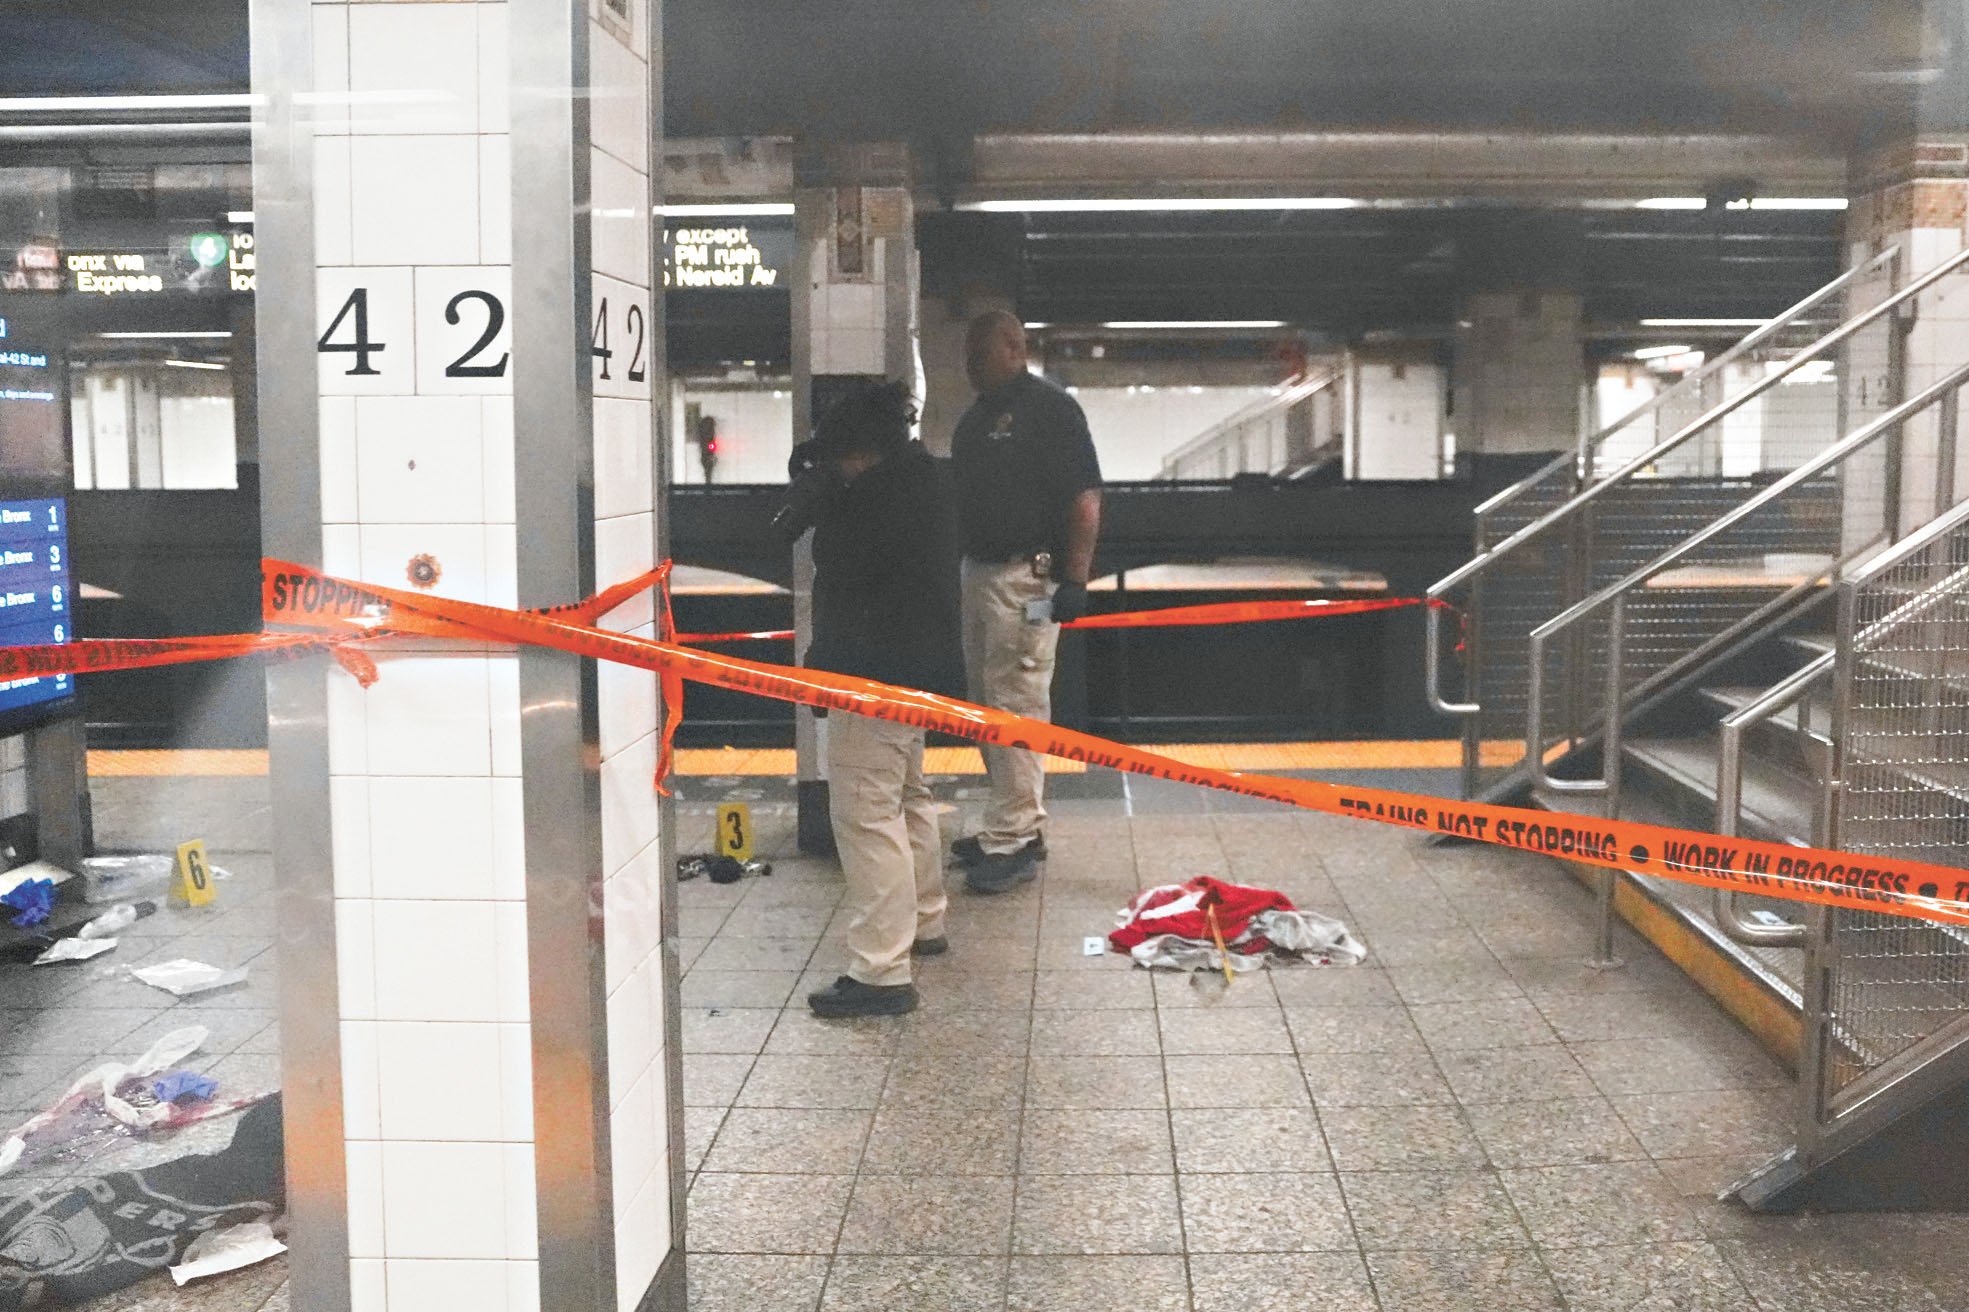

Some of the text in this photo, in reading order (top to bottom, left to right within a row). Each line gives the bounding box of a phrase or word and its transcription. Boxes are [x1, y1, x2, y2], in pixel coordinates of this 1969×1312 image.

[199, 236, 217, 259] 4
[676, 226, 749, 247] except
[675, 244, 761, 265] PM rush
[77, 271, 163, 295] Express
[2, 509, 31, 523] Bronx
[48, 505, 57, 523] 1
[4, 551, 33, 565] Bronx
[50, 545, 60, 563] 3
[7, 592, 36, 606] Bronx
[52, 584, 62, 603] 6
[54, 624, 64, 642] 6
[727, 811, 744, 849] 3
[1438, 811, 1488, 840] NOT
[1497, 819, 1617, 862] STOPPING
[1663, 840, 1738, 882] WORK
[1745, 852, 1770, 887] IN
[1776, 857, 1910, 905] PROGRESS
[188, 849, 206, 890] 6
